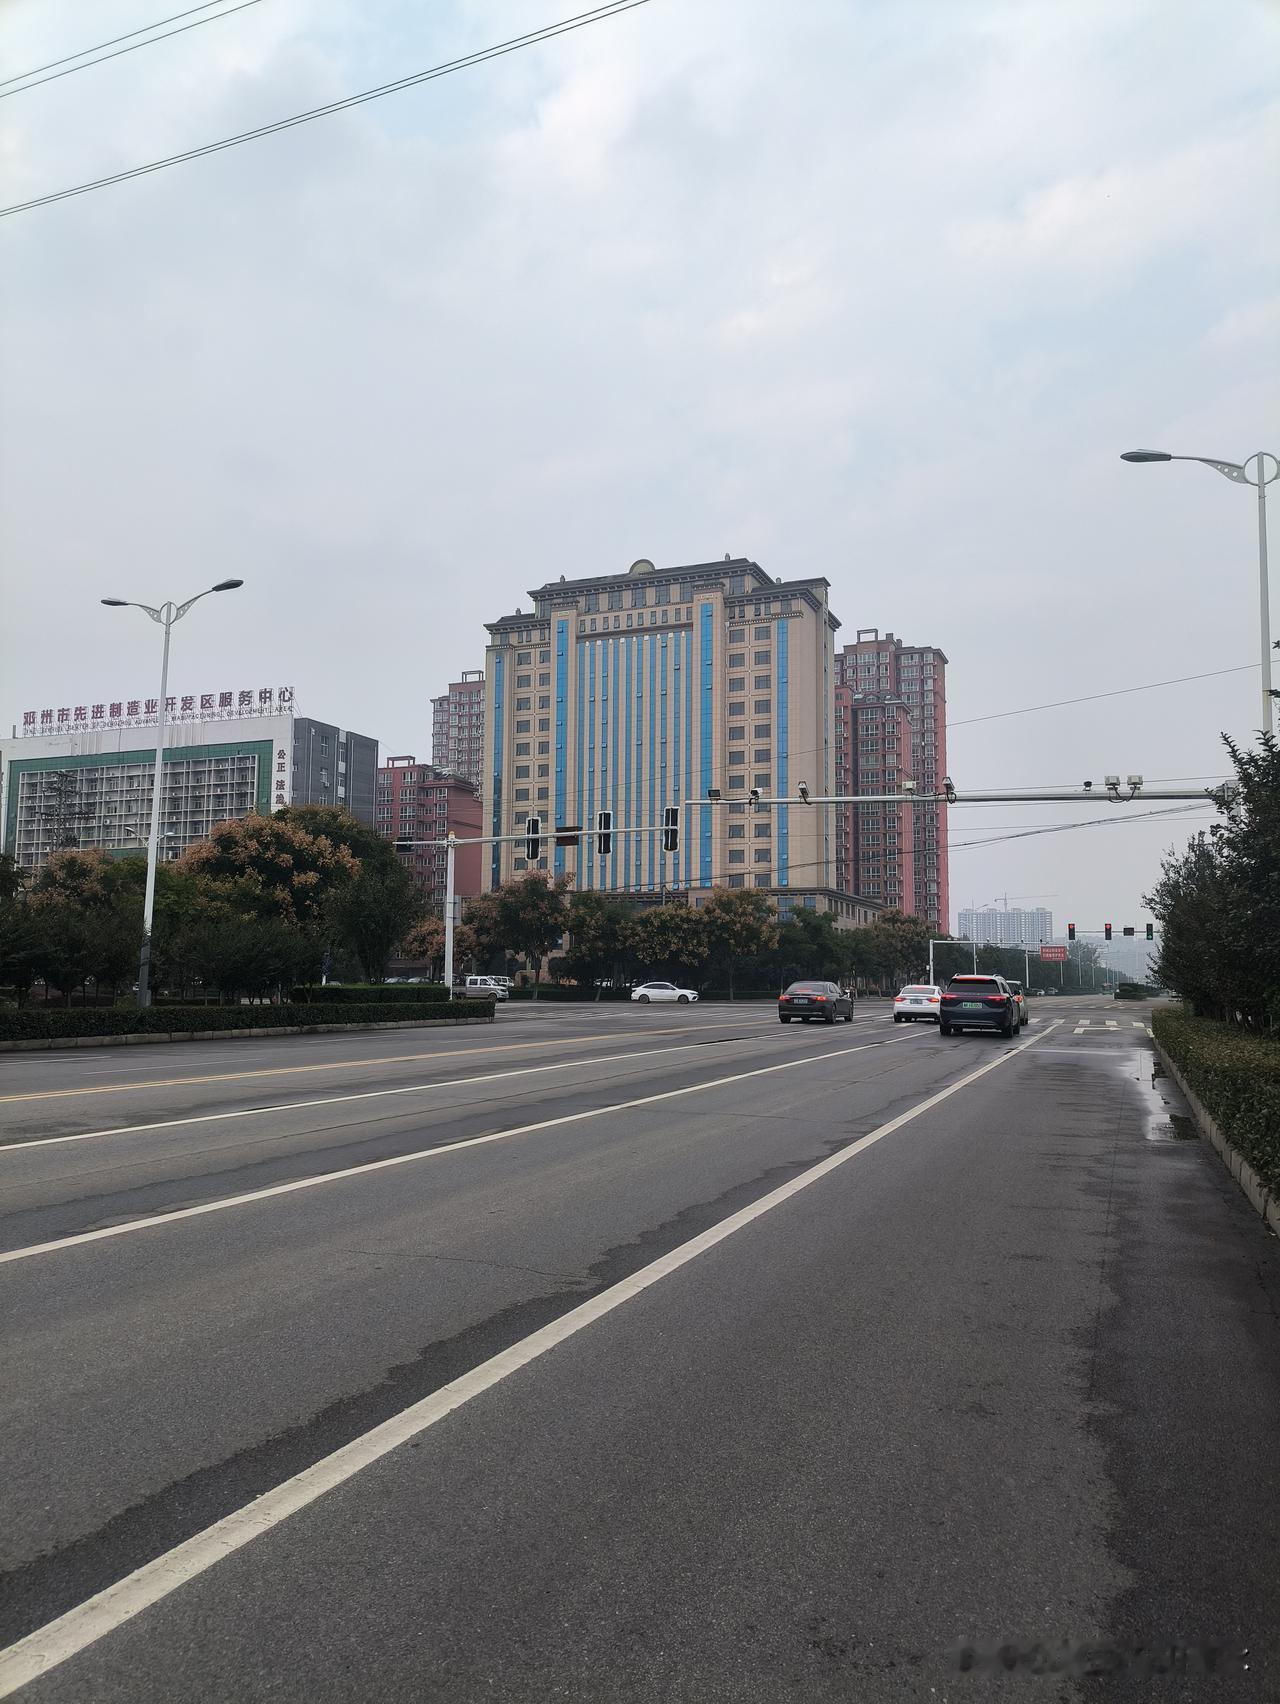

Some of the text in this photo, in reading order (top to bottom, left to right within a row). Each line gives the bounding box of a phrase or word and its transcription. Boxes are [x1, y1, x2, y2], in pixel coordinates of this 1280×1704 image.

[23, 687, 293, 726] 邓州市先进制造业开发区服务中心
